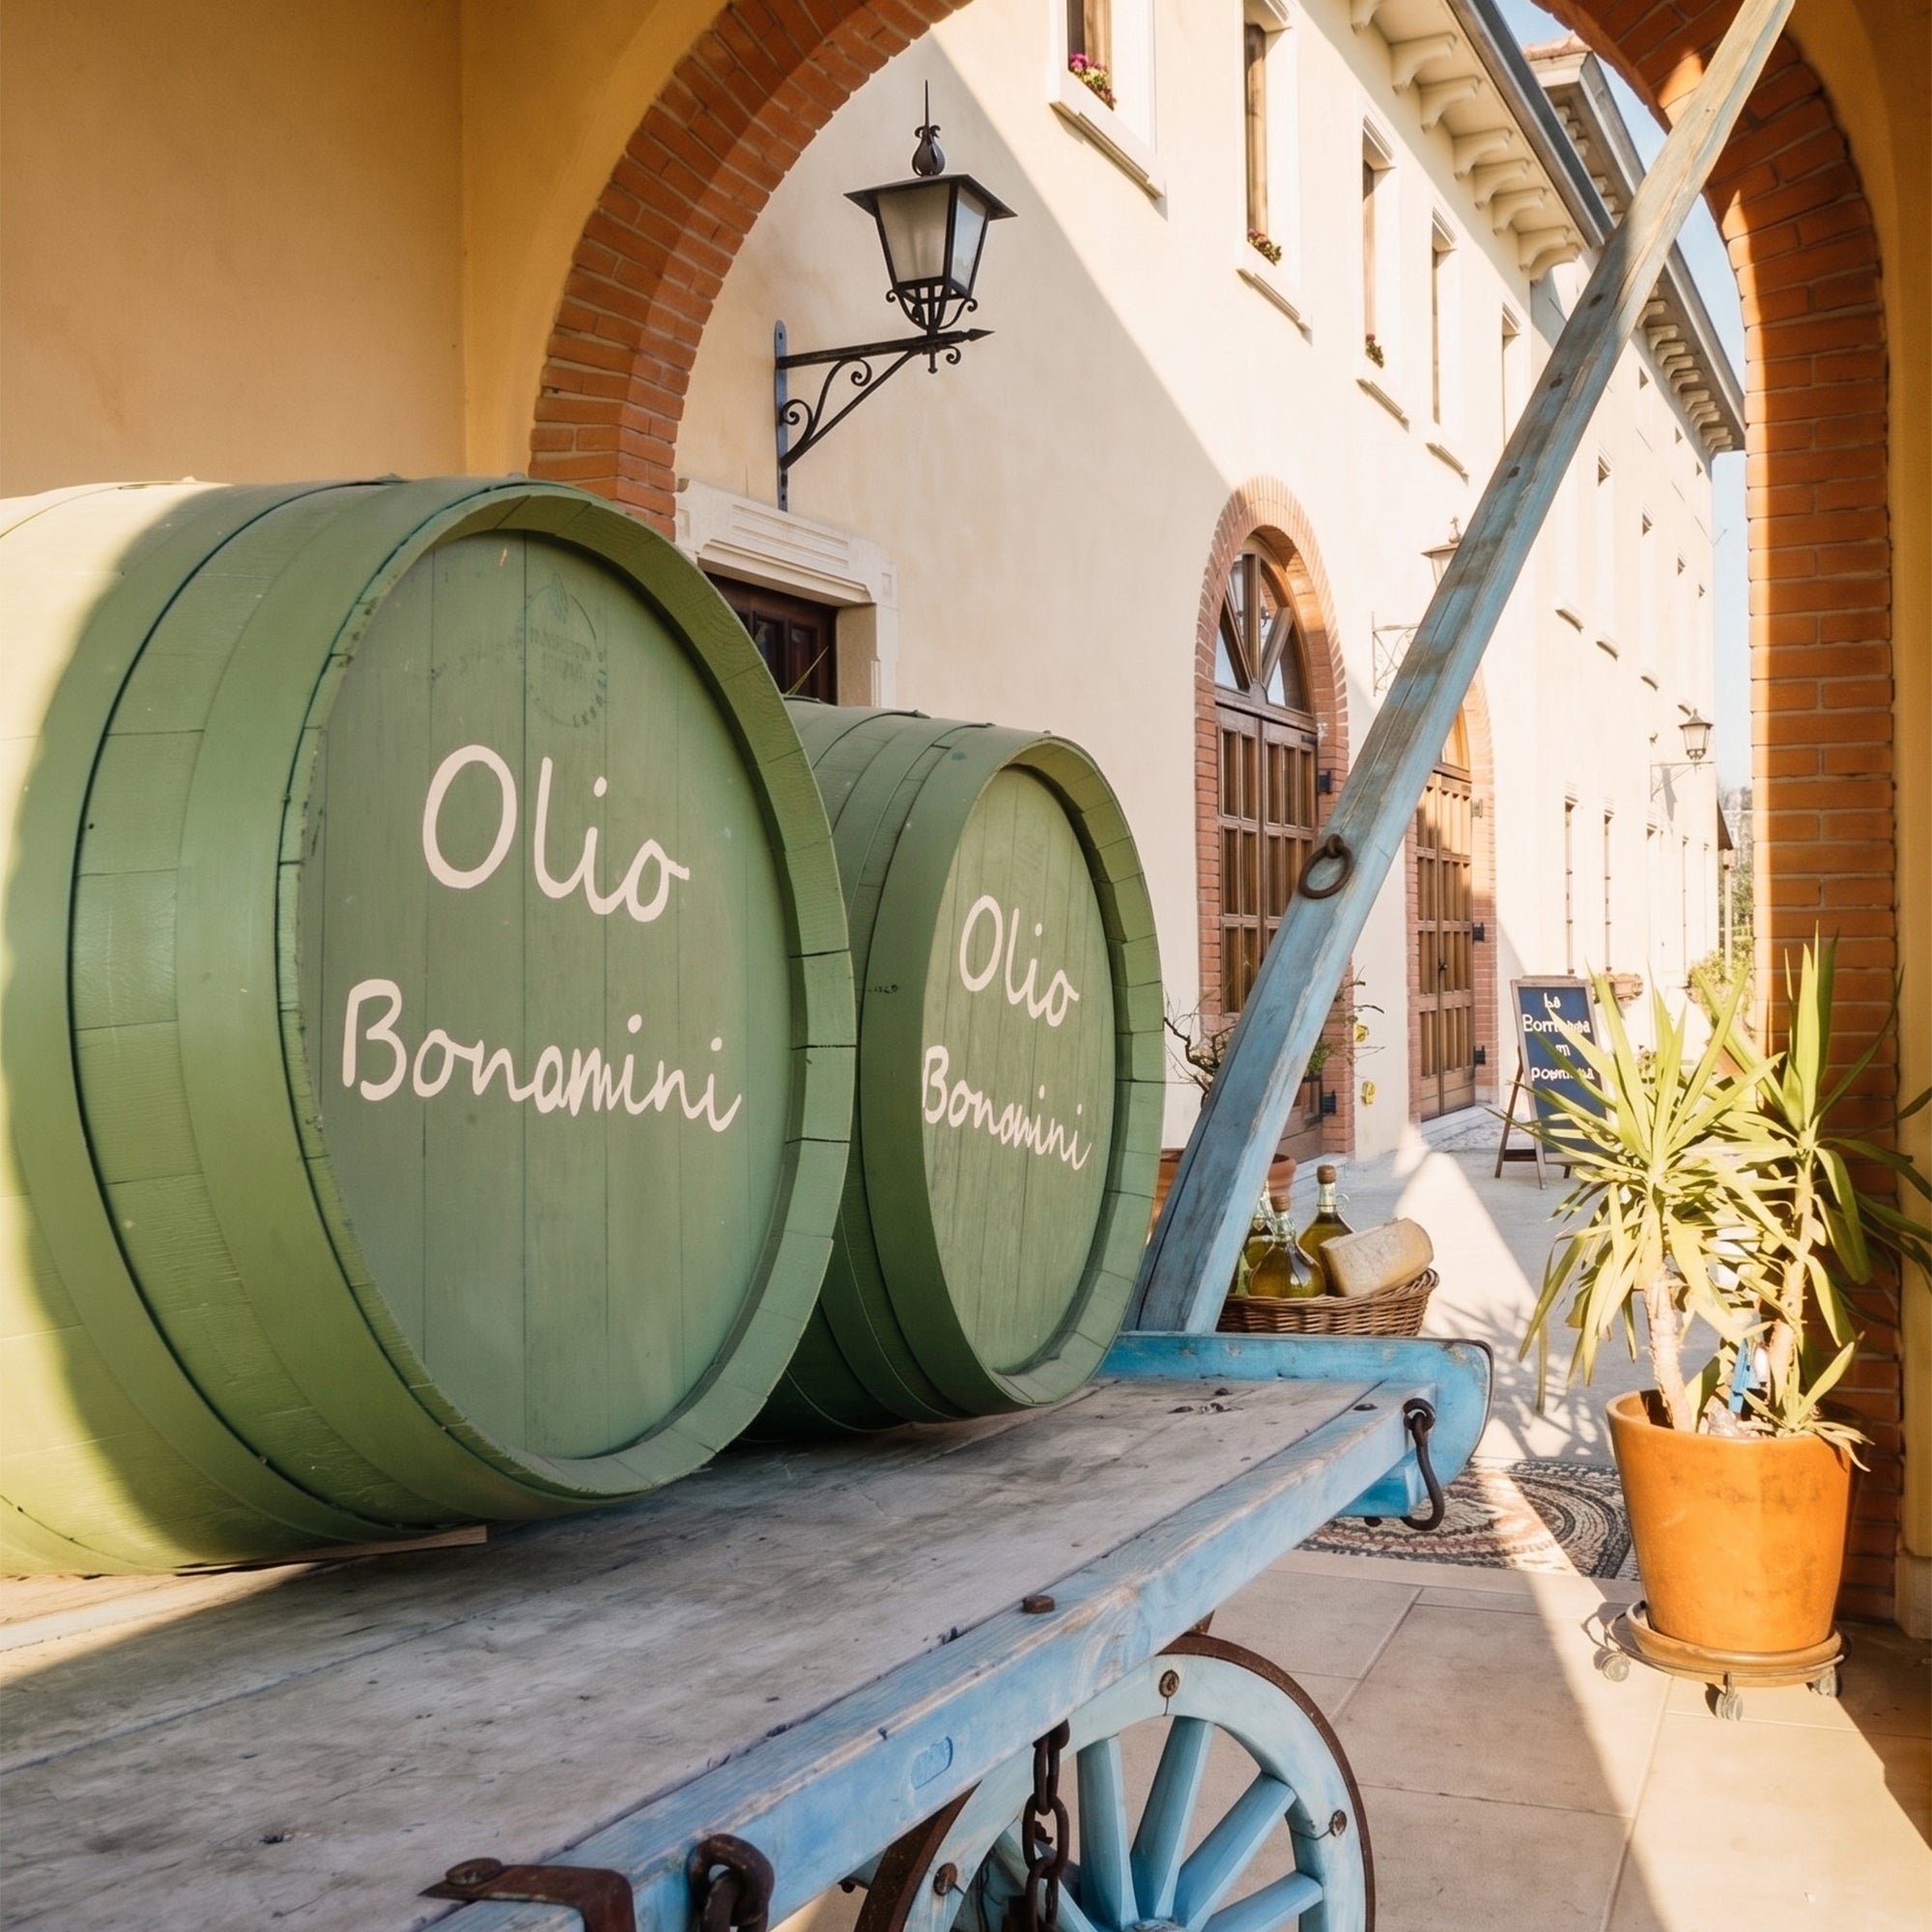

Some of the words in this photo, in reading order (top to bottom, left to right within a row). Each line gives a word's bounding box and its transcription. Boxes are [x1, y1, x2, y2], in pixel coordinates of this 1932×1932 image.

[422, 745, 690, 923] Olio
[959, 895, 1080, 1027] Olio
[342, 979, 742, 1133] Bonamini
[923, 1044, 1093, 1171] Bonamini
